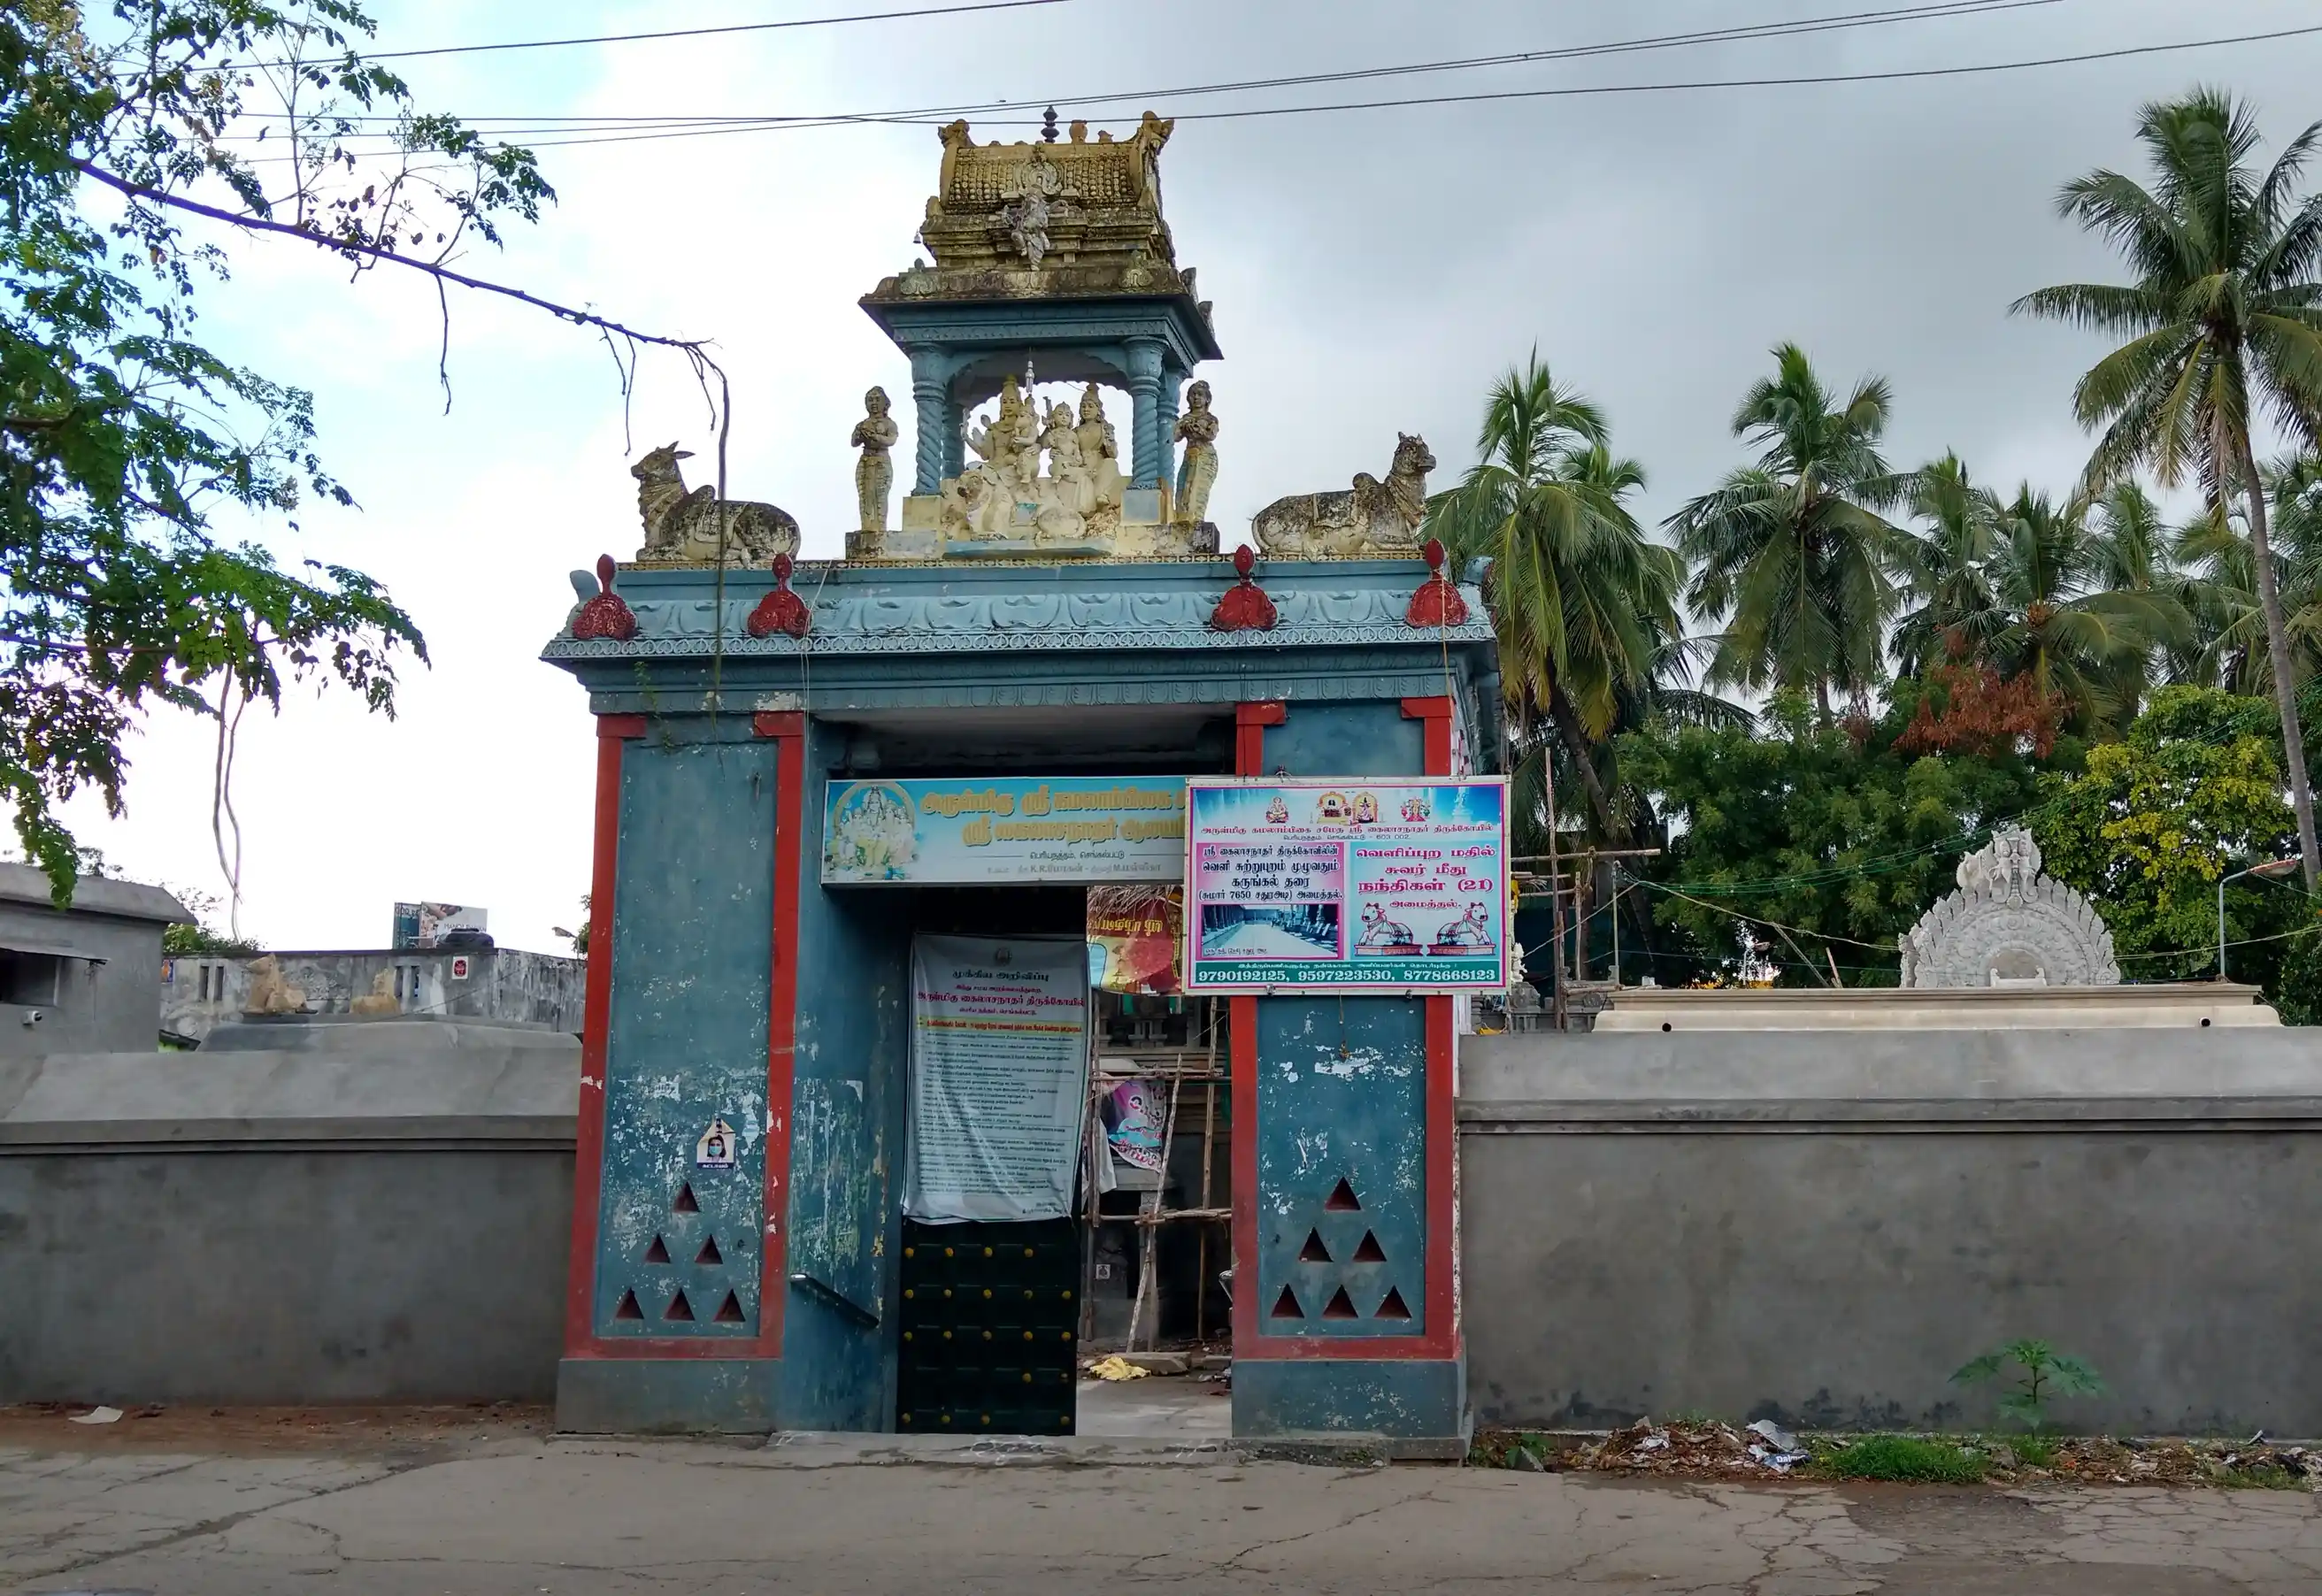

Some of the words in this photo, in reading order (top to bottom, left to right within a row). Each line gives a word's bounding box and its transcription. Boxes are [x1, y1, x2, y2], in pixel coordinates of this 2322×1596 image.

[922, 788, 1015, 818] அருள்மிகு
[1201, 825, 1247, 835] அருள்மிகு
[1251, 825, 1311, 834] கமலாம்பிகை
[1367, 824, 1430, 833] கைலாசநாதர்
[1433, 824, 1494, 834] திருக்கோயில்
[1030, 850, 1076, 862] பெரியநத்தம்,
[1080, 850, 1126, 860] செங்கல்பட்டு
[1220, 845, 1273, 857] கைலாசநாதர்
[1357, 847, 1442, 861] வெளிப்புற
[1450, 845, 1495, 859] மதில்
[1203, 860, 1230, 872] வெளி
[1235, 859, 1287, 874] சுற்றுபுறம்
[1291, 859, 1339, 874] முழுவதும்
[1385, 863, 1426, 876] சுவர்
[1435, 863, 1467, 876] மீது
[1231, 874, 1280, 888] கருங்கல்
[1284, 876, 1310, 888] தரை
[1358, 878, 1445, 894] நந்திகள்
[1457, 879, 1494, 893] (21)
[1198, 889, 1226, 901] (சுமார்
[1230, 890, 1251, 900] 7650
[1296, 889, 1344, 902] அமைத்தல்.
[1389, 899, 1462, 909] அமைத்தல்.
[953, 969, 993, 979] முக்கிய
[996, 970, 1050, 981] அறிவிப்பு
[1198, 971, 1290, 982] 9790192125,
[1298, 970, 1396, 982] 9597223530,
[1403, 970, 1495, 981] 8778668123
[961, 993, 1024, 1005] கைலாசநாதர்
[1026, 995, 1086, 1008] திருக்கோயில்
